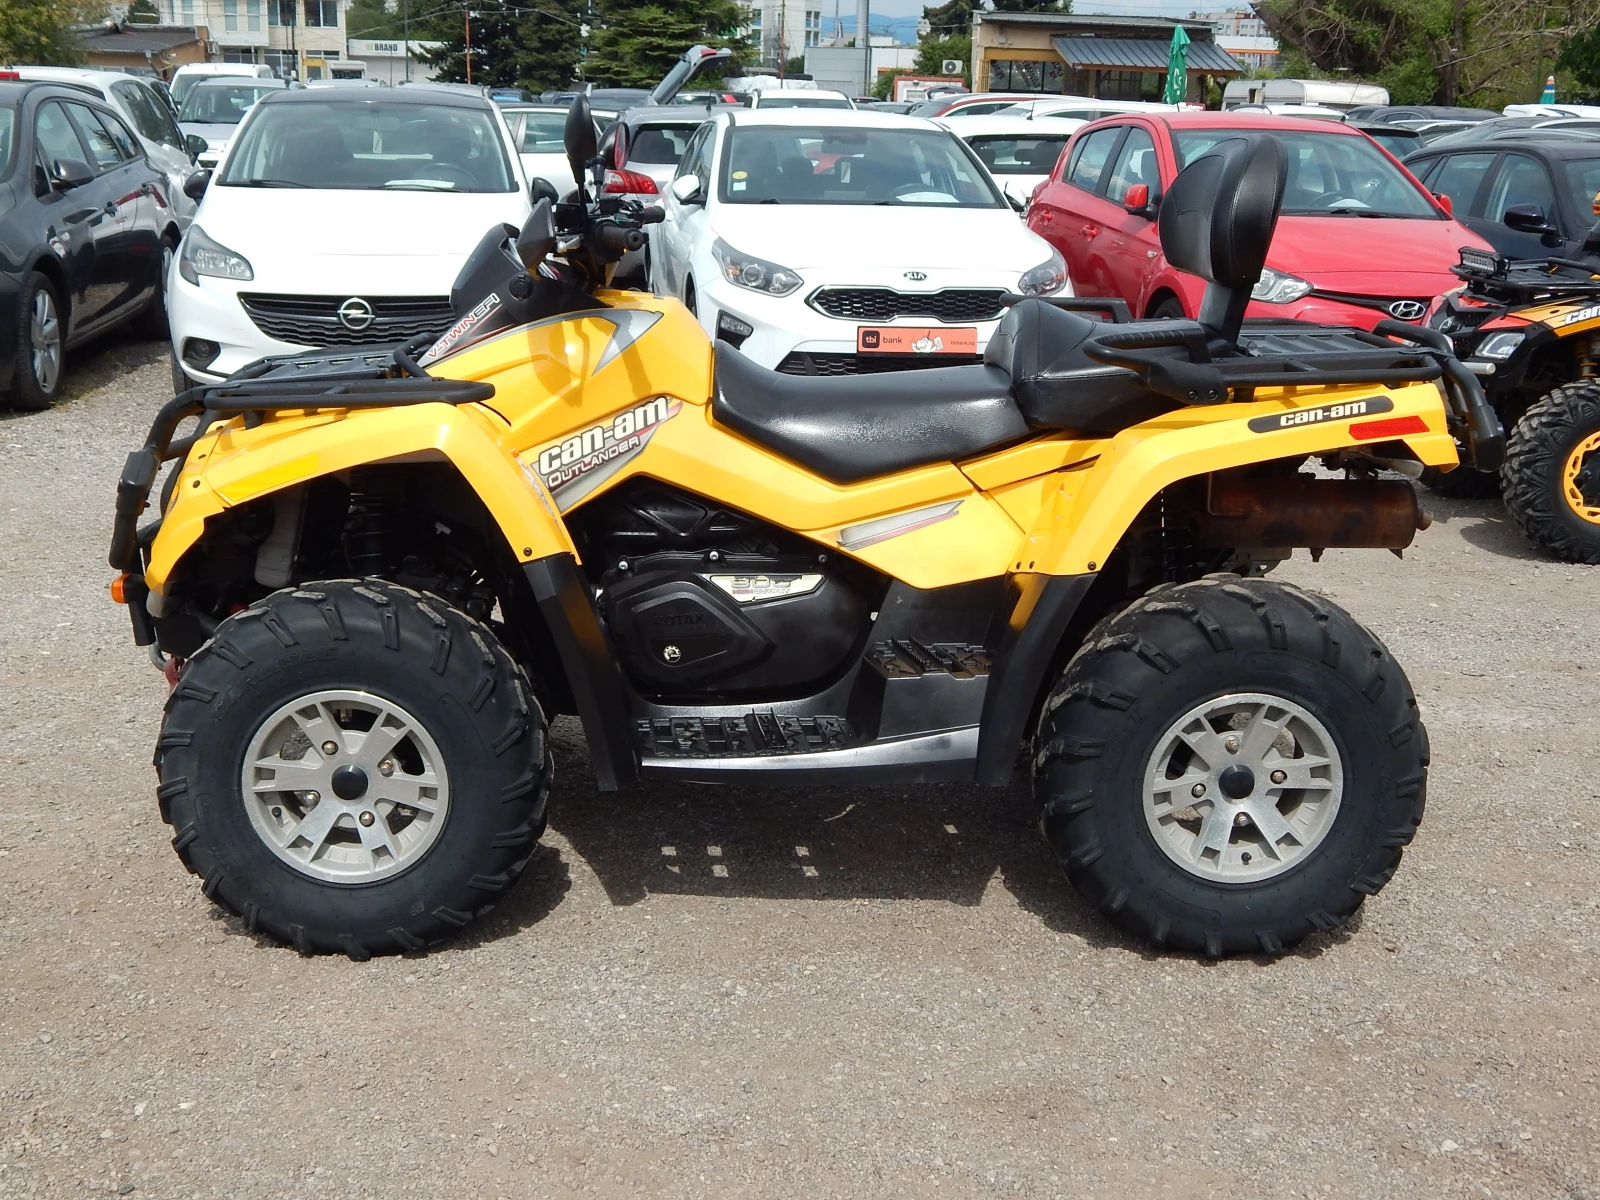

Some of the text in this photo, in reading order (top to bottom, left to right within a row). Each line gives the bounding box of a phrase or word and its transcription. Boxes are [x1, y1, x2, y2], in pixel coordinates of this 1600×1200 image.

[905, 272, 926, 280] KIA
[427, 314, 476, 358] V-TWIN
[865, 335, 902, 344] tbi bank
[1280, 401, 1366, 426] can-am
[538, 396, 669, 477] can-am
[547, 435, 641, 487] OUTLANDER
[654, 613, 707, 627] ROTAX
